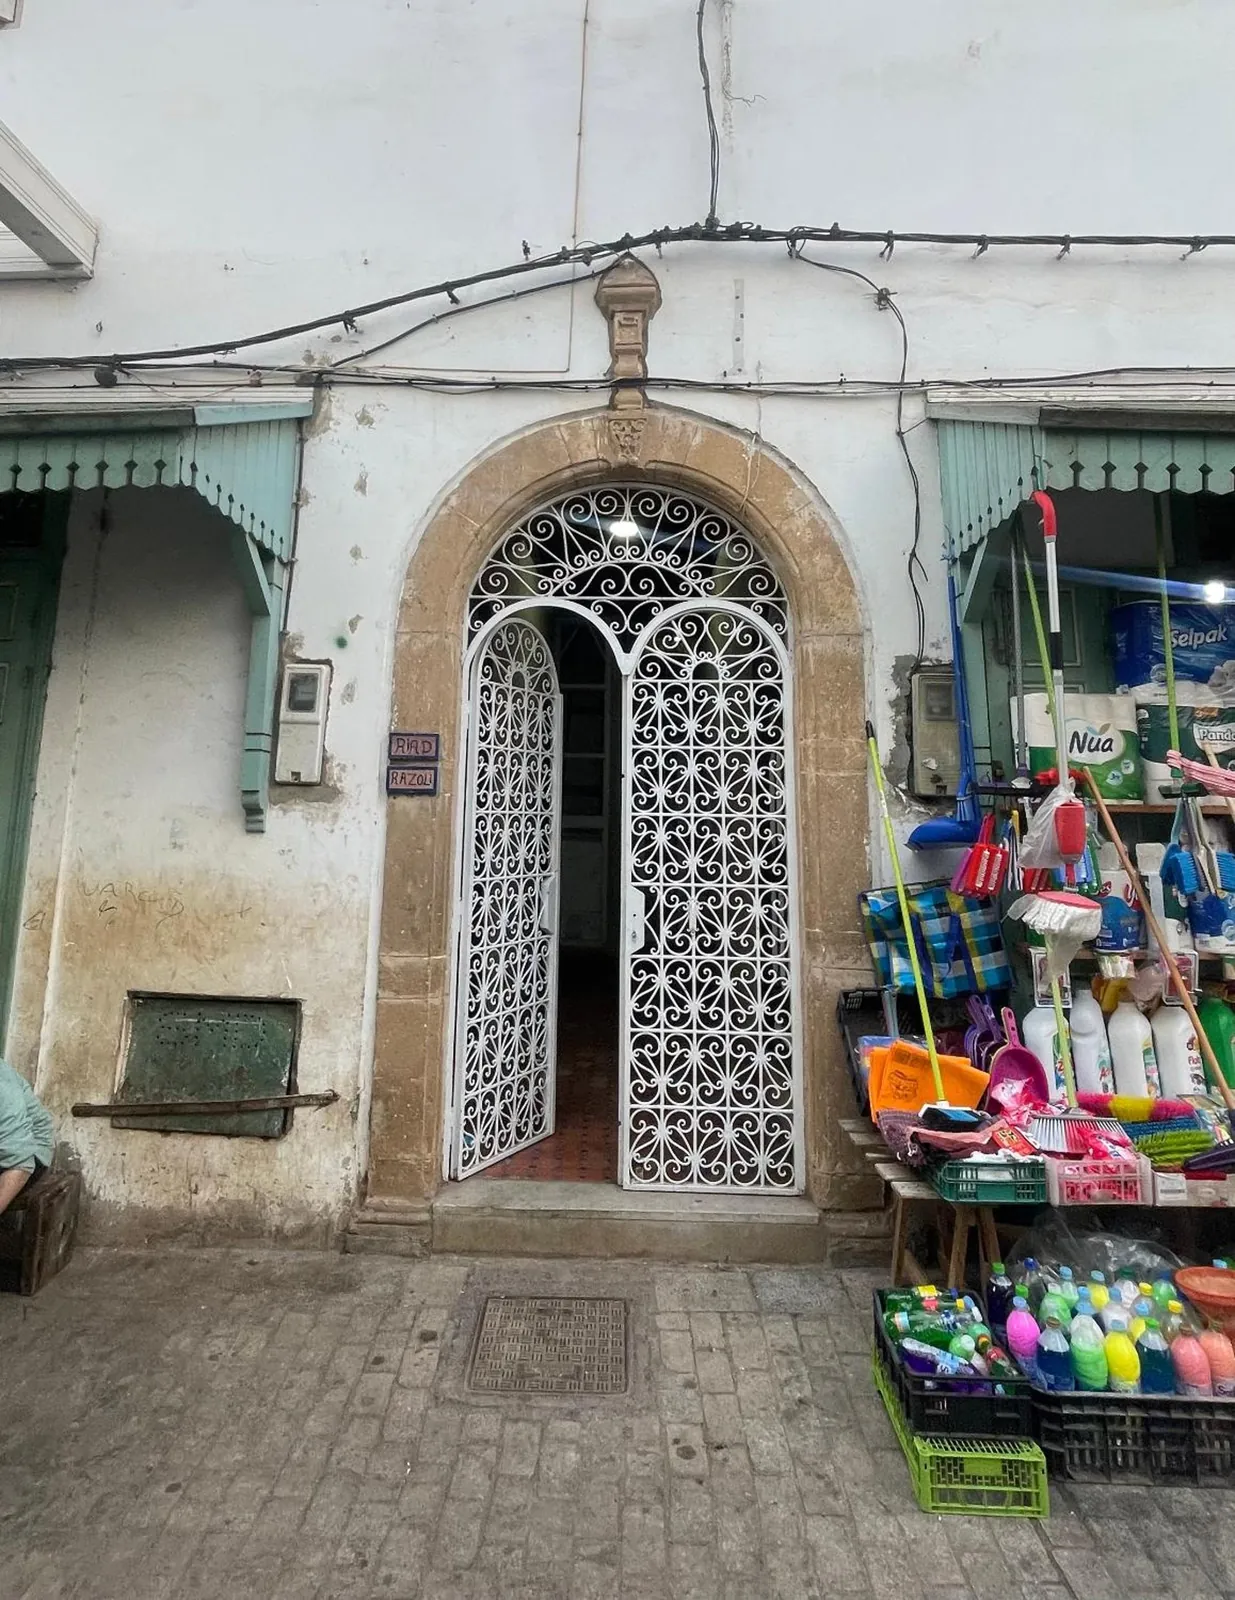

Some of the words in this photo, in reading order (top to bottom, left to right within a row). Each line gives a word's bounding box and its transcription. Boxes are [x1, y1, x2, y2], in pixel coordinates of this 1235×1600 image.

[1170, 624, 1228, 650] Selpak
[393, 737, 433, 754] RIAD
[1069, 730, 1114, 754] Nua
